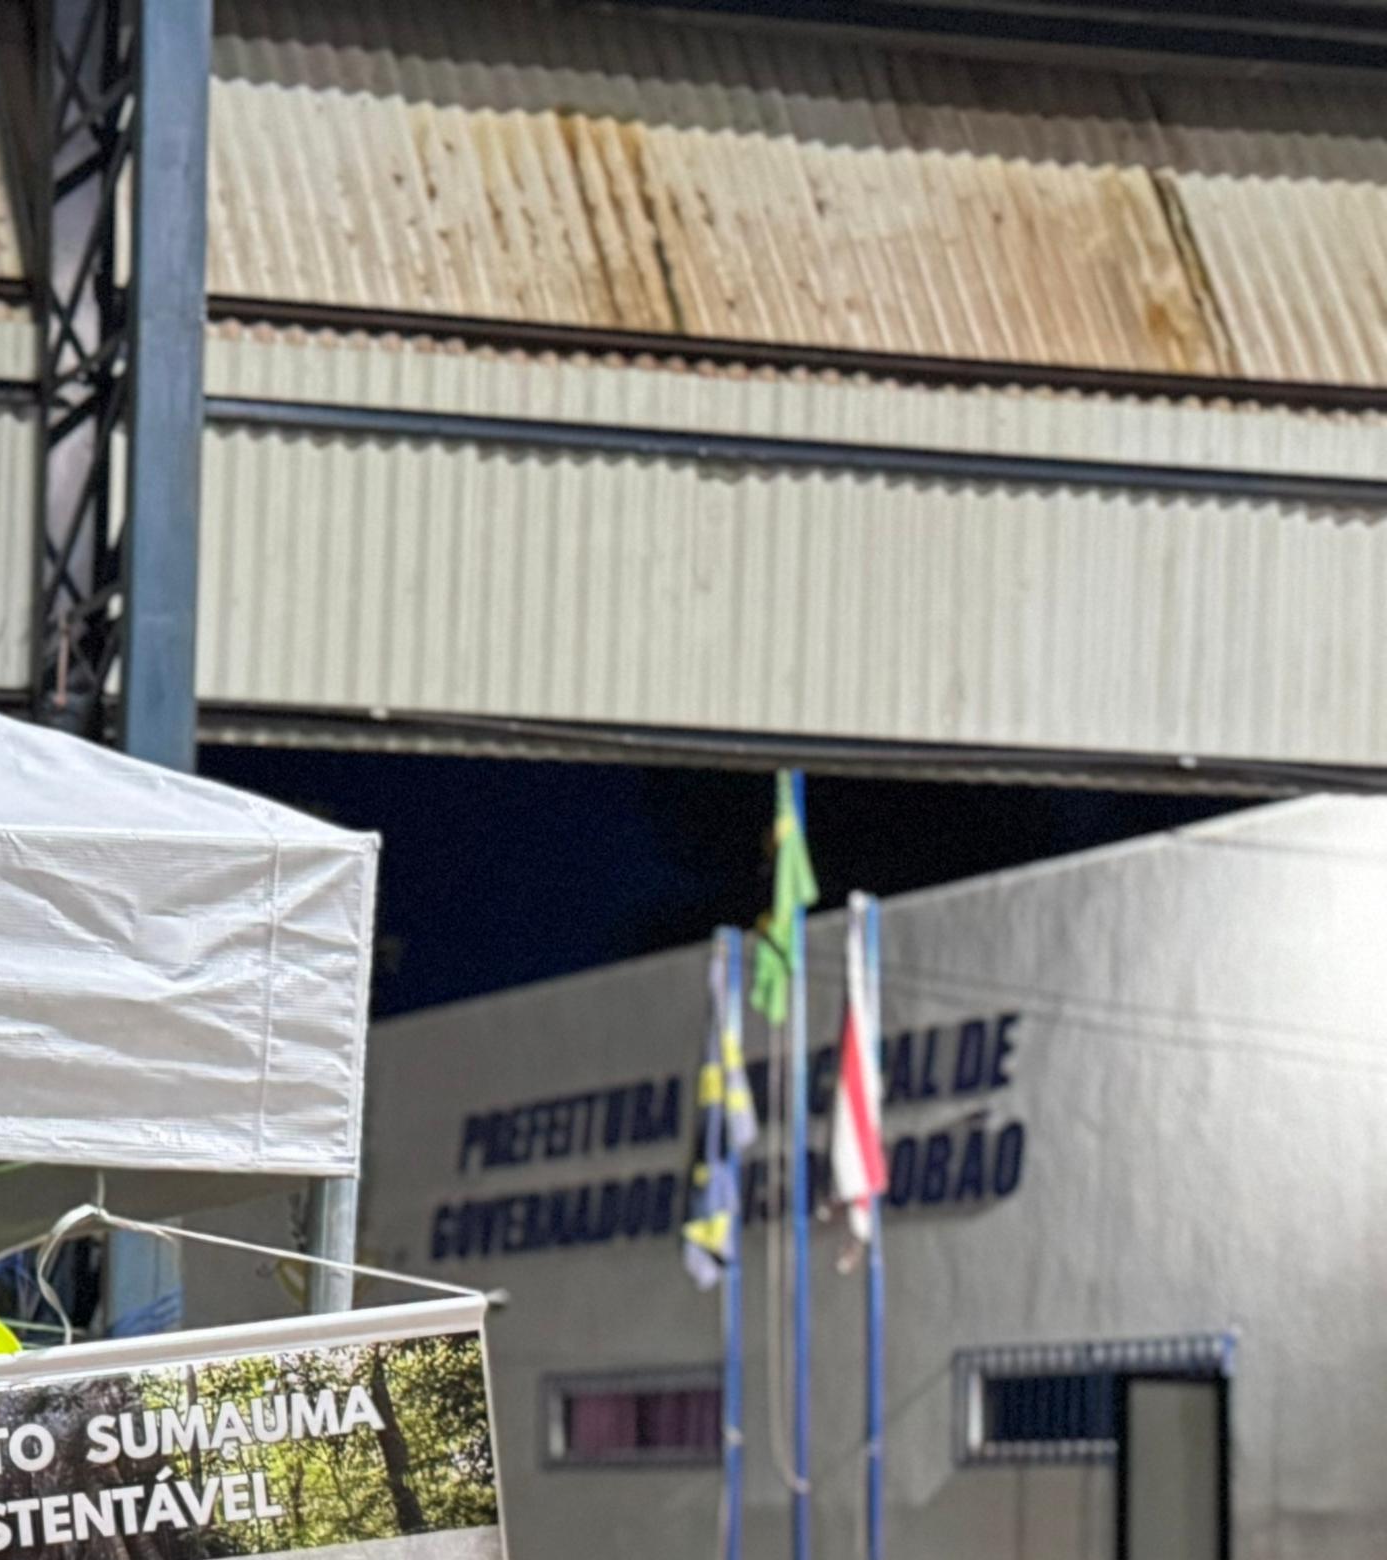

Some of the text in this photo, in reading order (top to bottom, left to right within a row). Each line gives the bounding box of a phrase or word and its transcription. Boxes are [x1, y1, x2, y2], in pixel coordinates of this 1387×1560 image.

[457, 1073, 681, 1179] PREFEITURA
[952, 1013, 1021, 1094] DE
[430, 1173, 676, 1262] GOVERNADOR
[885, 1108, 1025, 1208] OBÃO
[85, 1377, 387, 1465] SUMAÚMA
